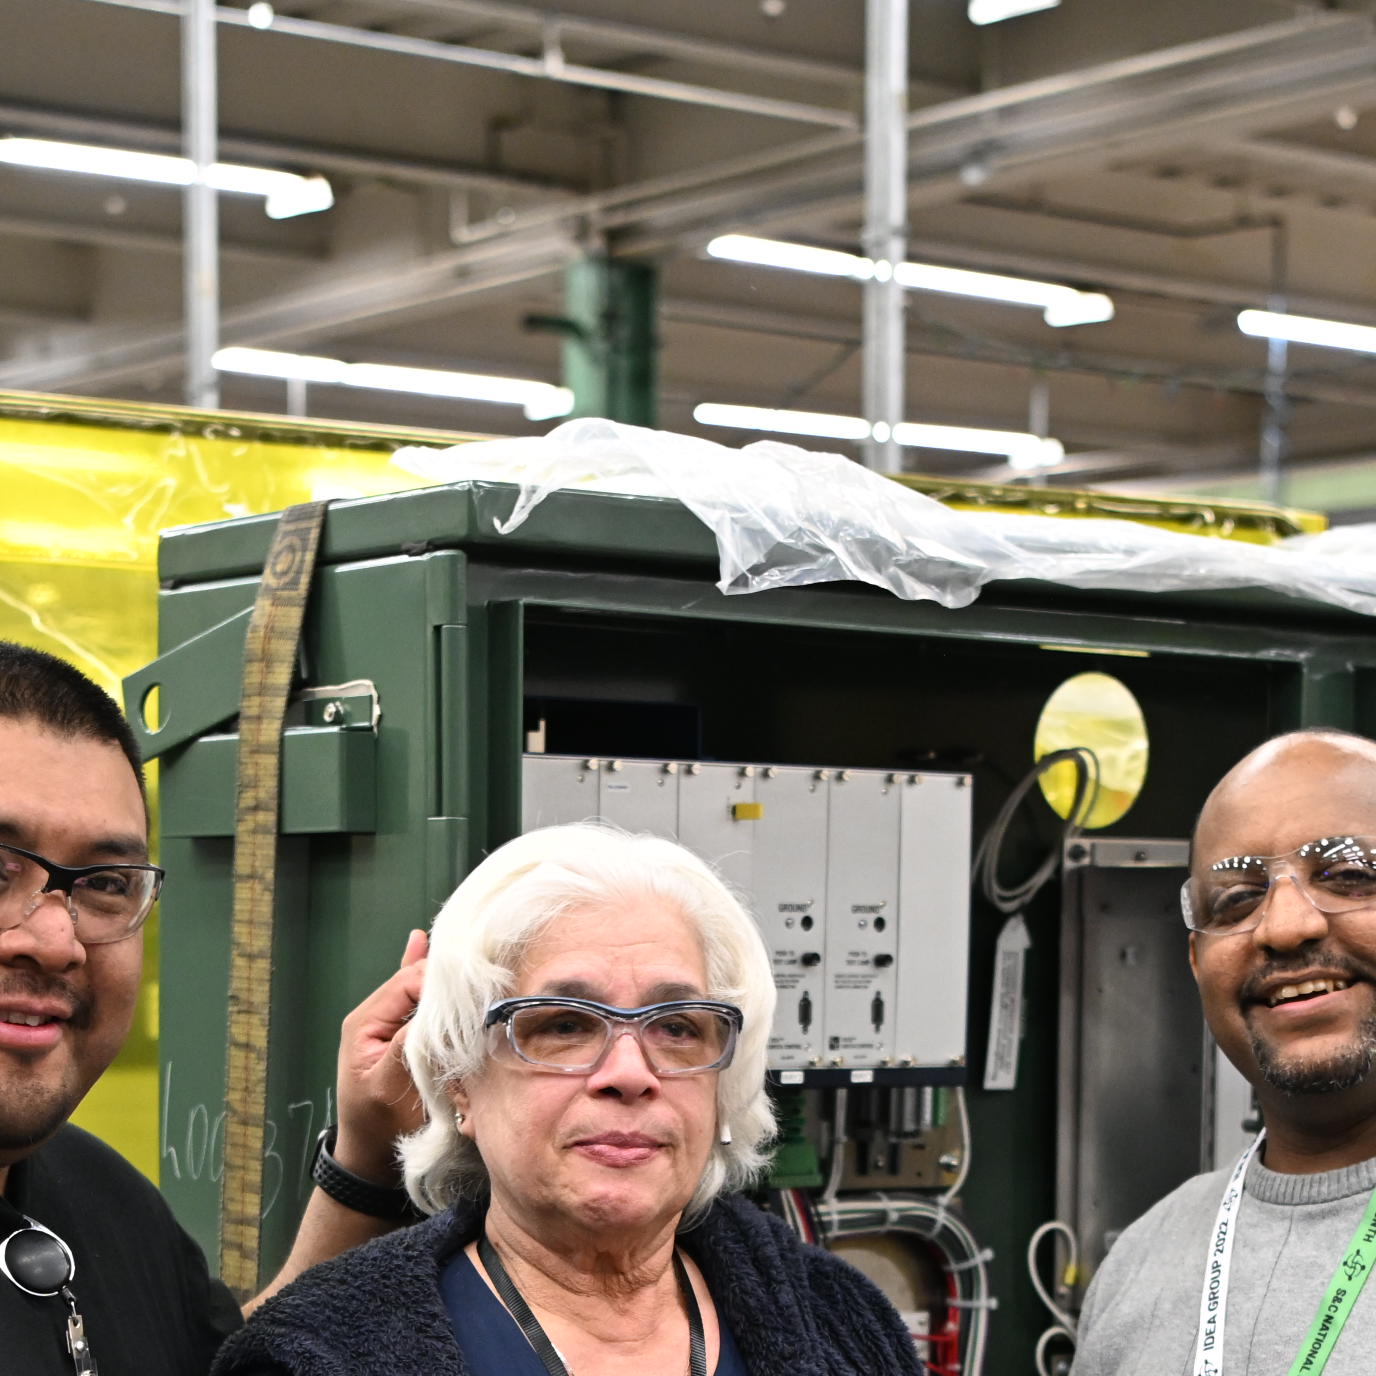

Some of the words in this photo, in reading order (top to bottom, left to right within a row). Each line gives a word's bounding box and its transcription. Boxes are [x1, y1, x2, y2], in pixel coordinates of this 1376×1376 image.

[1214, 1218, 1230, 1258] 2022
[1207, 1260, 1222, 1310] GROUP
[1328, 1287, 1346, 1313] S&C
[1203, 1311, 1218, 1351] IDEA
[1299, 1315, 1334, 1373] NATIONAL
